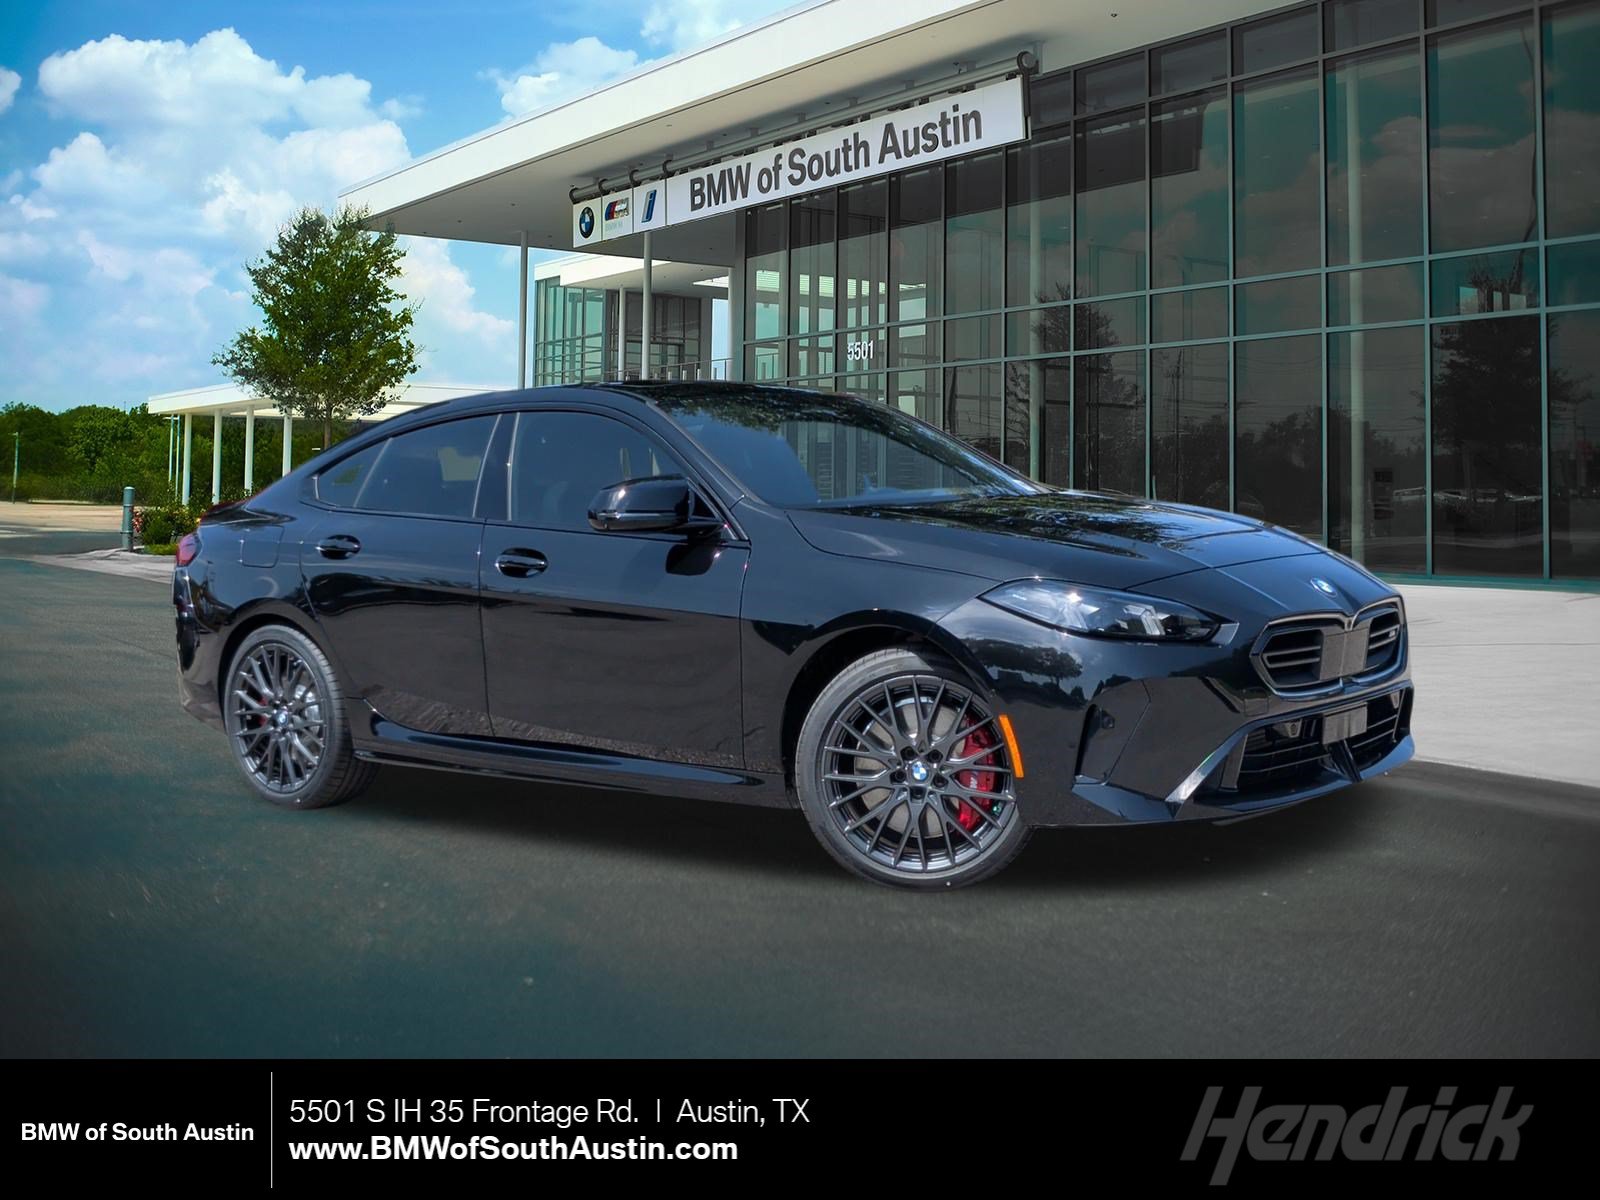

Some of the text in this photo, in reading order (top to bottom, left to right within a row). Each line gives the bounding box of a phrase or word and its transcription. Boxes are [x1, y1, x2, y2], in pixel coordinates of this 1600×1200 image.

[690, 103, 983, 212] BMW of South Austin
[847, 339, 874, 361] 5501
